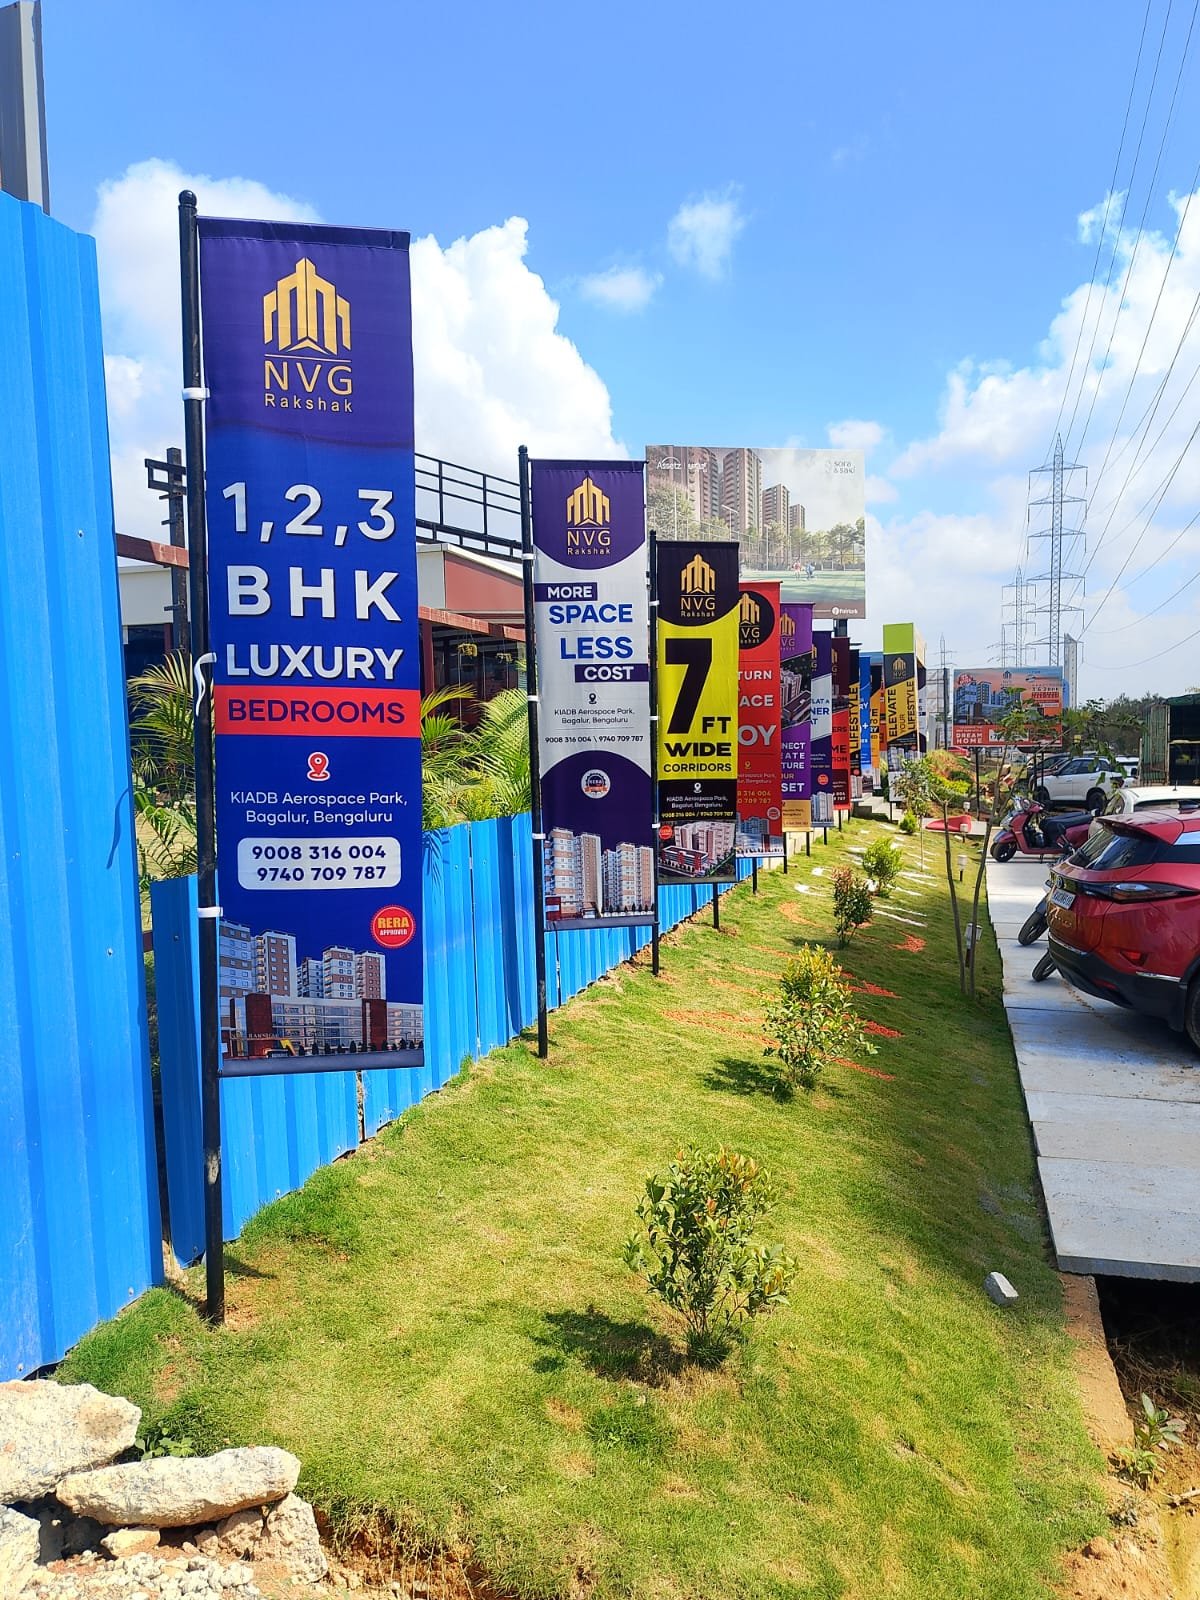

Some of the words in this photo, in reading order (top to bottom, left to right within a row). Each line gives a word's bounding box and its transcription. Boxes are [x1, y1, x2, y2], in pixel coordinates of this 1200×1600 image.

[264, 360, 353, 395] NVG
[265, 393, 353, 413] Rakshak
[567, 530, 611, 546] NVG
[567, 547, 611, 555] Rakshak
[227, 565, 402, 622] BHK
[547, 586, 593, 599] MORE
[681, 597, 716, 610] NVG
[549, 604, 633, 625] SPACE
[740, 627, 760, 638] VG
[560, 636, 634, 660] LESS
[226, 643, 403, 681] LUXURY
[584, 666, 634, 681] COST
[738, 670, 772, 680] TURN
[665, 638, 713, 734] 7
[702, 716, 731, 734] FT
[739, 694, 774, 707] ACE
[907, 681, 915, 730] LIFESTYLE
[228, 698, 405, 725] BEDROOMS
[554, 708, 577, 716] KIADB
[578, 708, 616, 717] Aerospace
[810, 707, 830, 715] NER
[888, 689, 897, 737] ELEVATE
[561, 717, 591, 725] Bagalur,
[593, 716, 629, 725] Bengaluru
[738, 724, 777, 746] OY
[664, 743, 731, 757] WIDE
[781, 742, 806, 750] NECT
[663, 763, 732, 773] CORRIDORS
[781, 783, 805, 792] SET
[230, 791, 278, 804] KIADB
[282, 792, 366, 807] Aerospace
[369, 792, 408, 806] Park,
[246, 810, 310, 825] Bagalur,
[313, 811, 393, 825] Bengaluru
[252, 846, 302, 860] 9008
[309, 846, 342, 859] 316
[349, 845, 386, 859] 004
[257, 867, 304, 882] 9740
[311, 867, 347, 881] 709
[353, 866, 386, 880] 787
[377, 917, 410, 929] RERA
